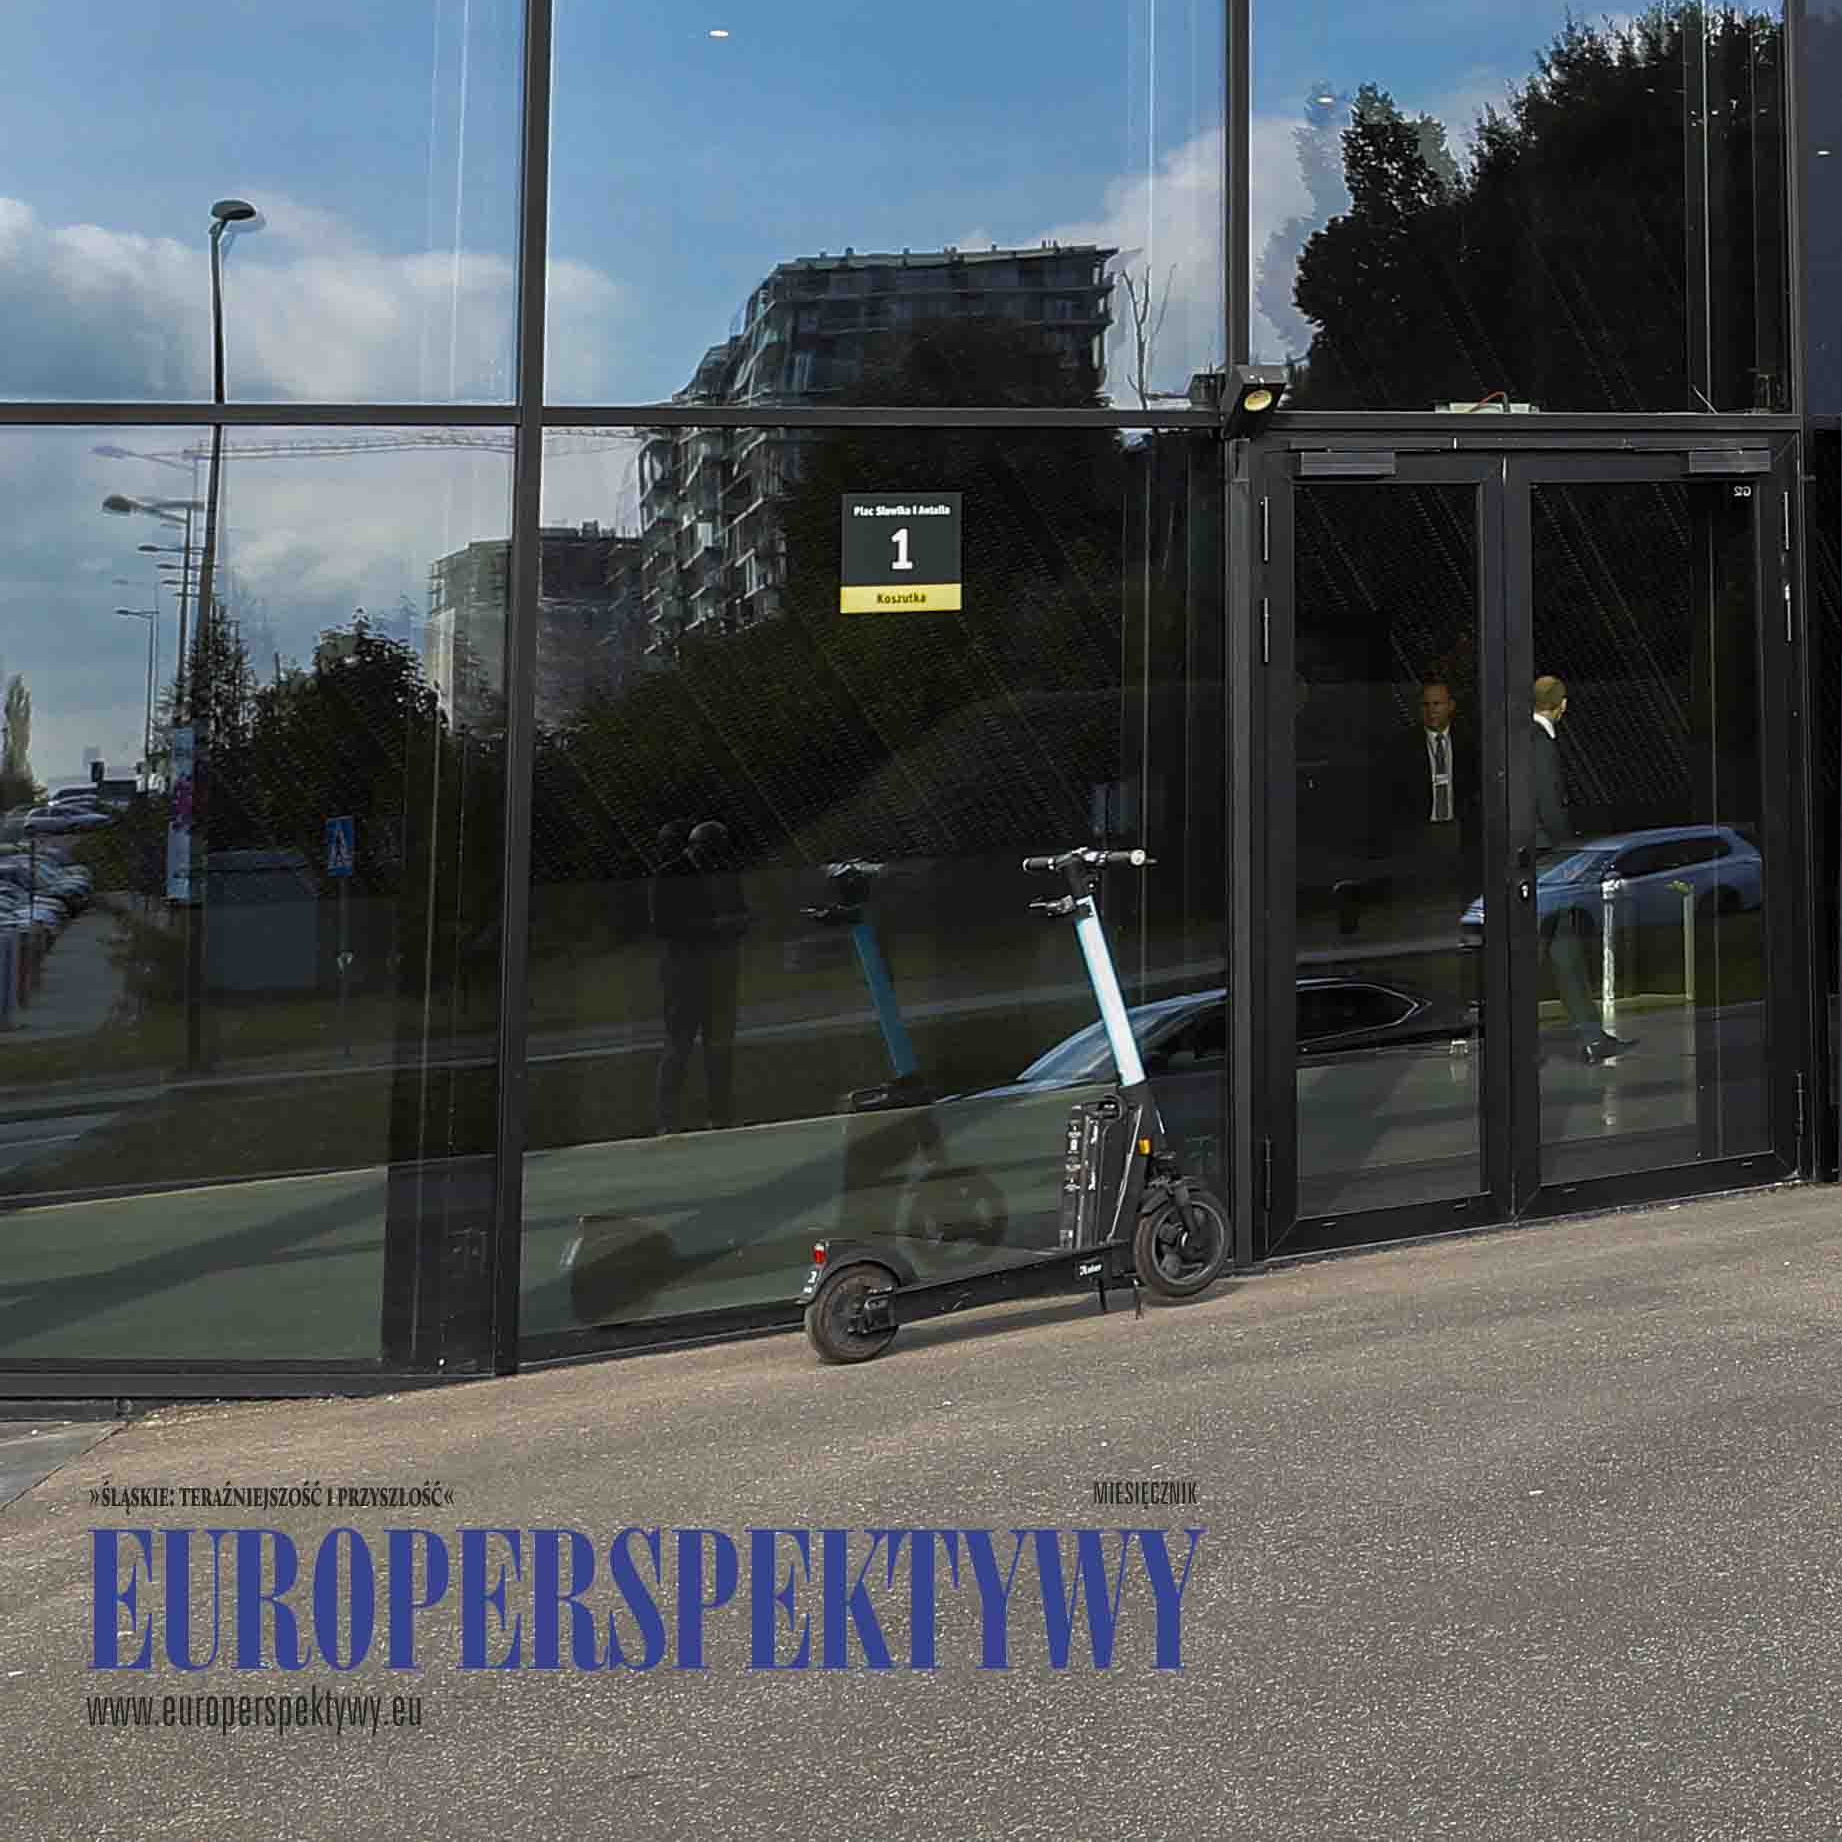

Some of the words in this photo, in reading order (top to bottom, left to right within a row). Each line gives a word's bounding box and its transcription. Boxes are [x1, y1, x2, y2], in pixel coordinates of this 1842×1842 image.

[853, 505, 874, 517] Plac
[891, 528, 913, 570] 1
[877, 592, 927, 605] Koszutka
